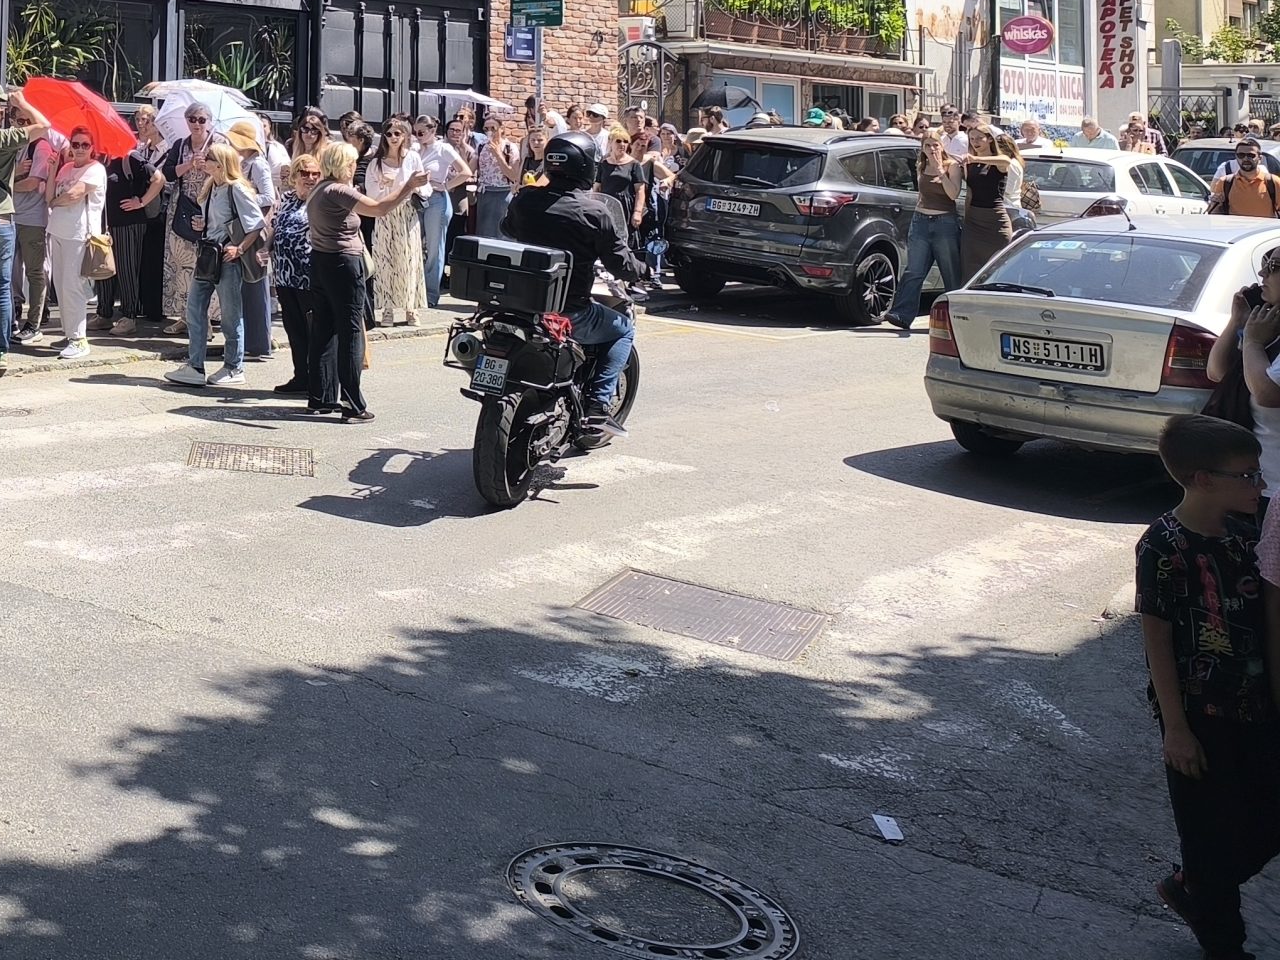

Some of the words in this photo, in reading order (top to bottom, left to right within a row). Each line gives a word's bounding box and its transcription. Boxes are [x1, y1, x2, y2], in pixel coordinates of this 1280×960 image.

[1004, 28, 1048, 41] whiskas
[1119, 36, 1135, 89] SHOP
[1000, 69, 1025, 96] OTO
[712, 200, 722, 210] BG
[1012, 338, 1031, 355] NS
[484, 358, 497, 370] BG
